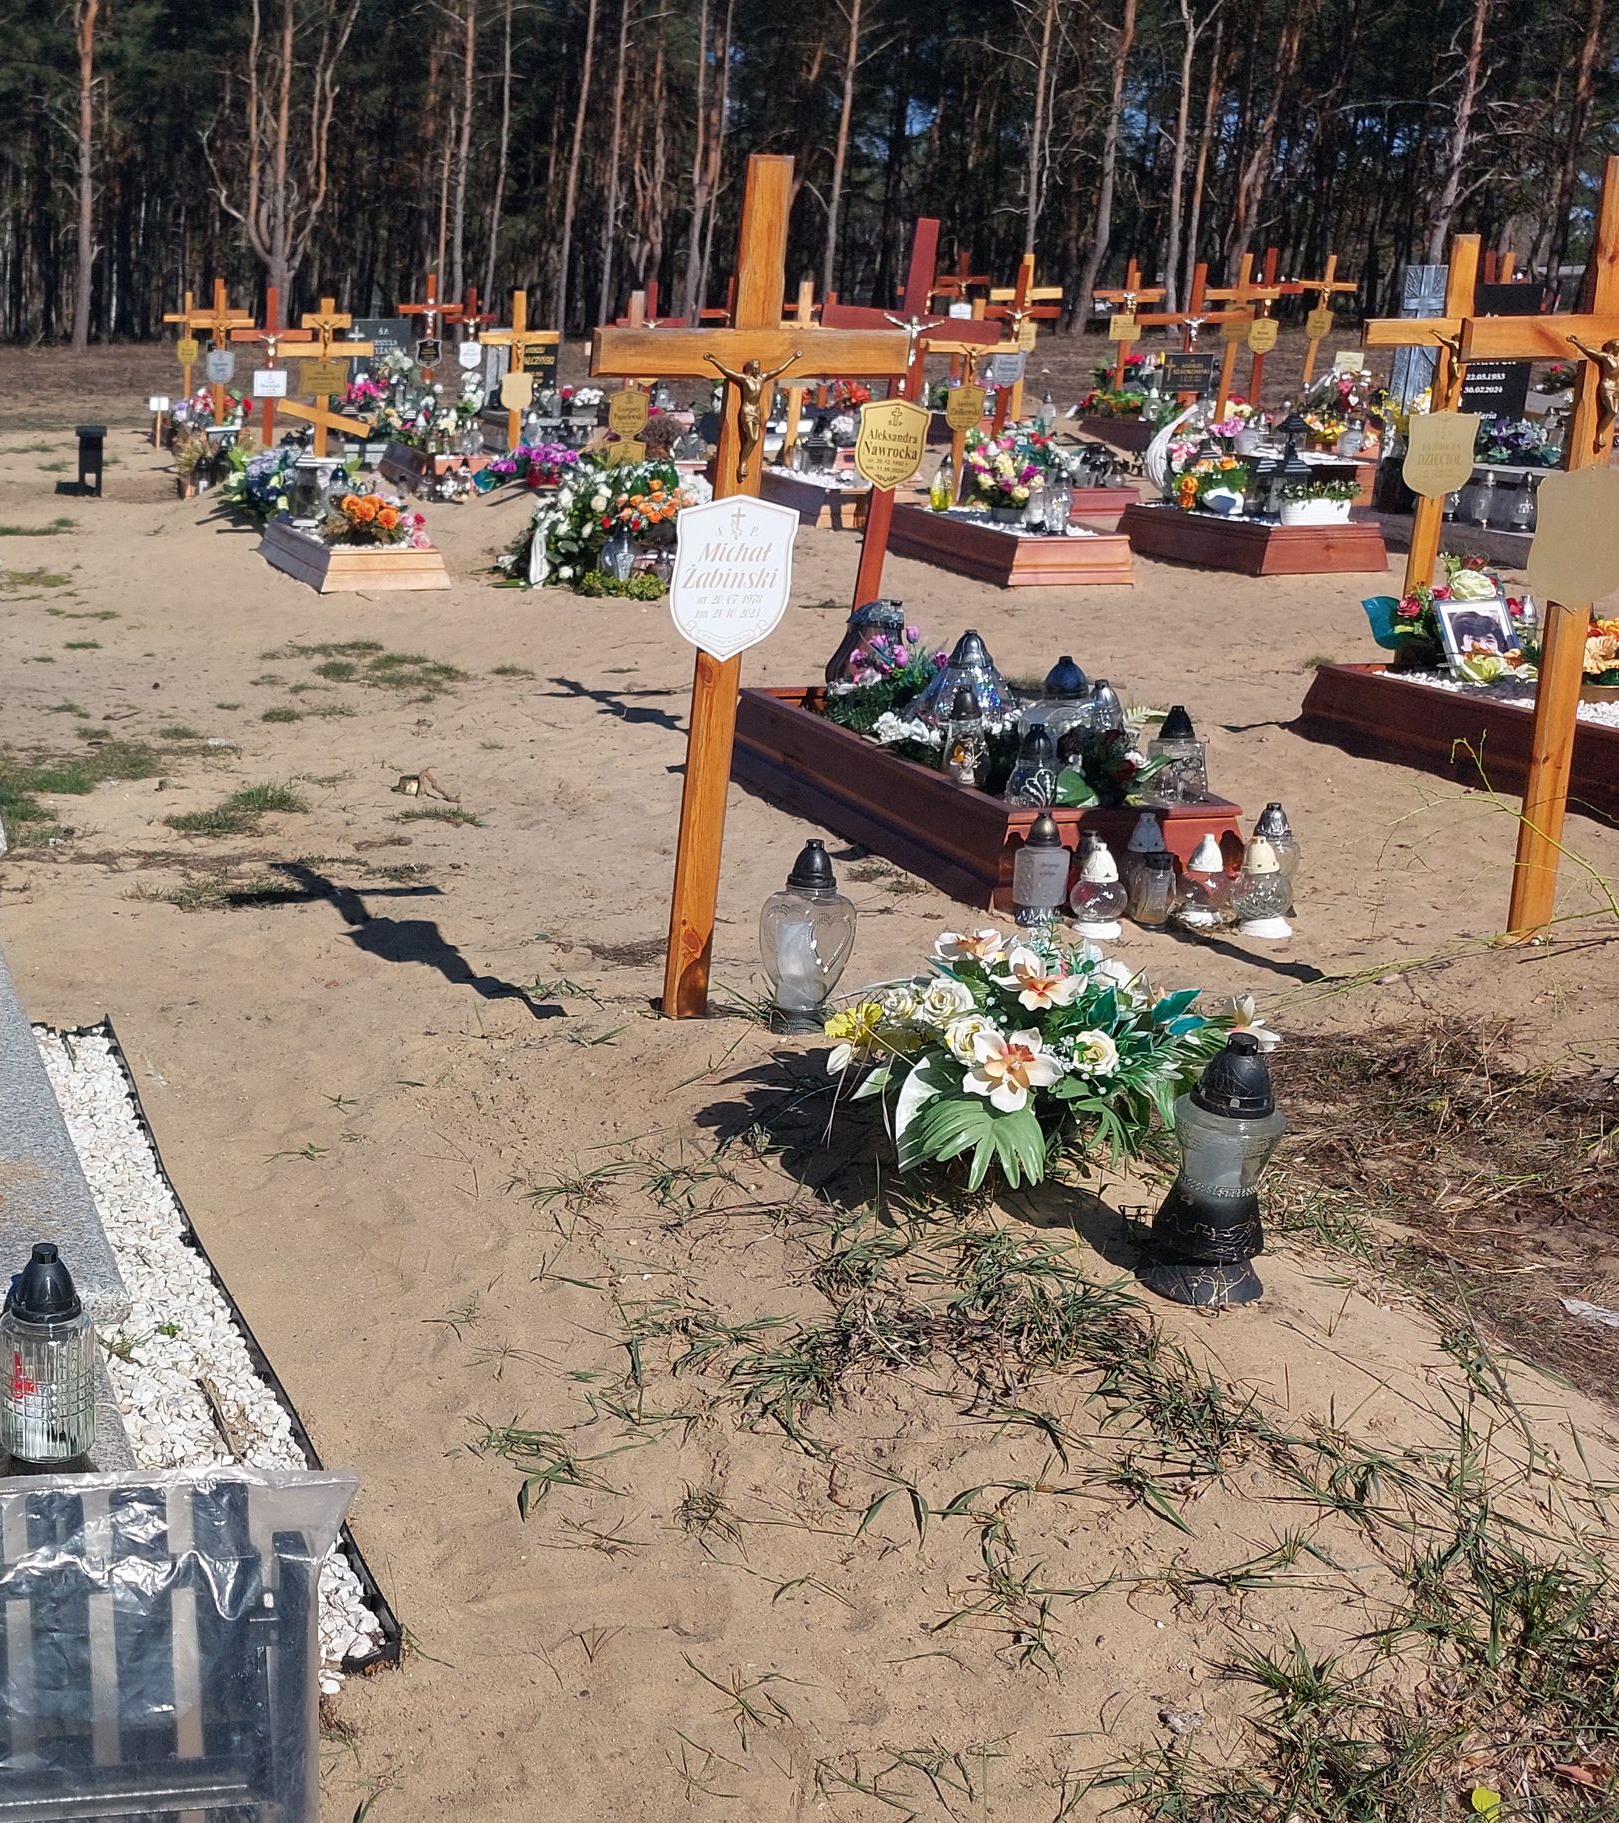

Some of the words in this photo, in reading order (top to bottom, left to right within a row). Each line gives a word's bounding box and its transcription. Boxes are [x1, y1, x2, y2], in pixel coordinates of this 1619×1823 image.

[867, 428, 918, 445] Aleksandra
[863, 440, 918, 461] Nawrocka
[698, 542, 773, 563] Michał
[682, 563, 779, 590] Żabiński
